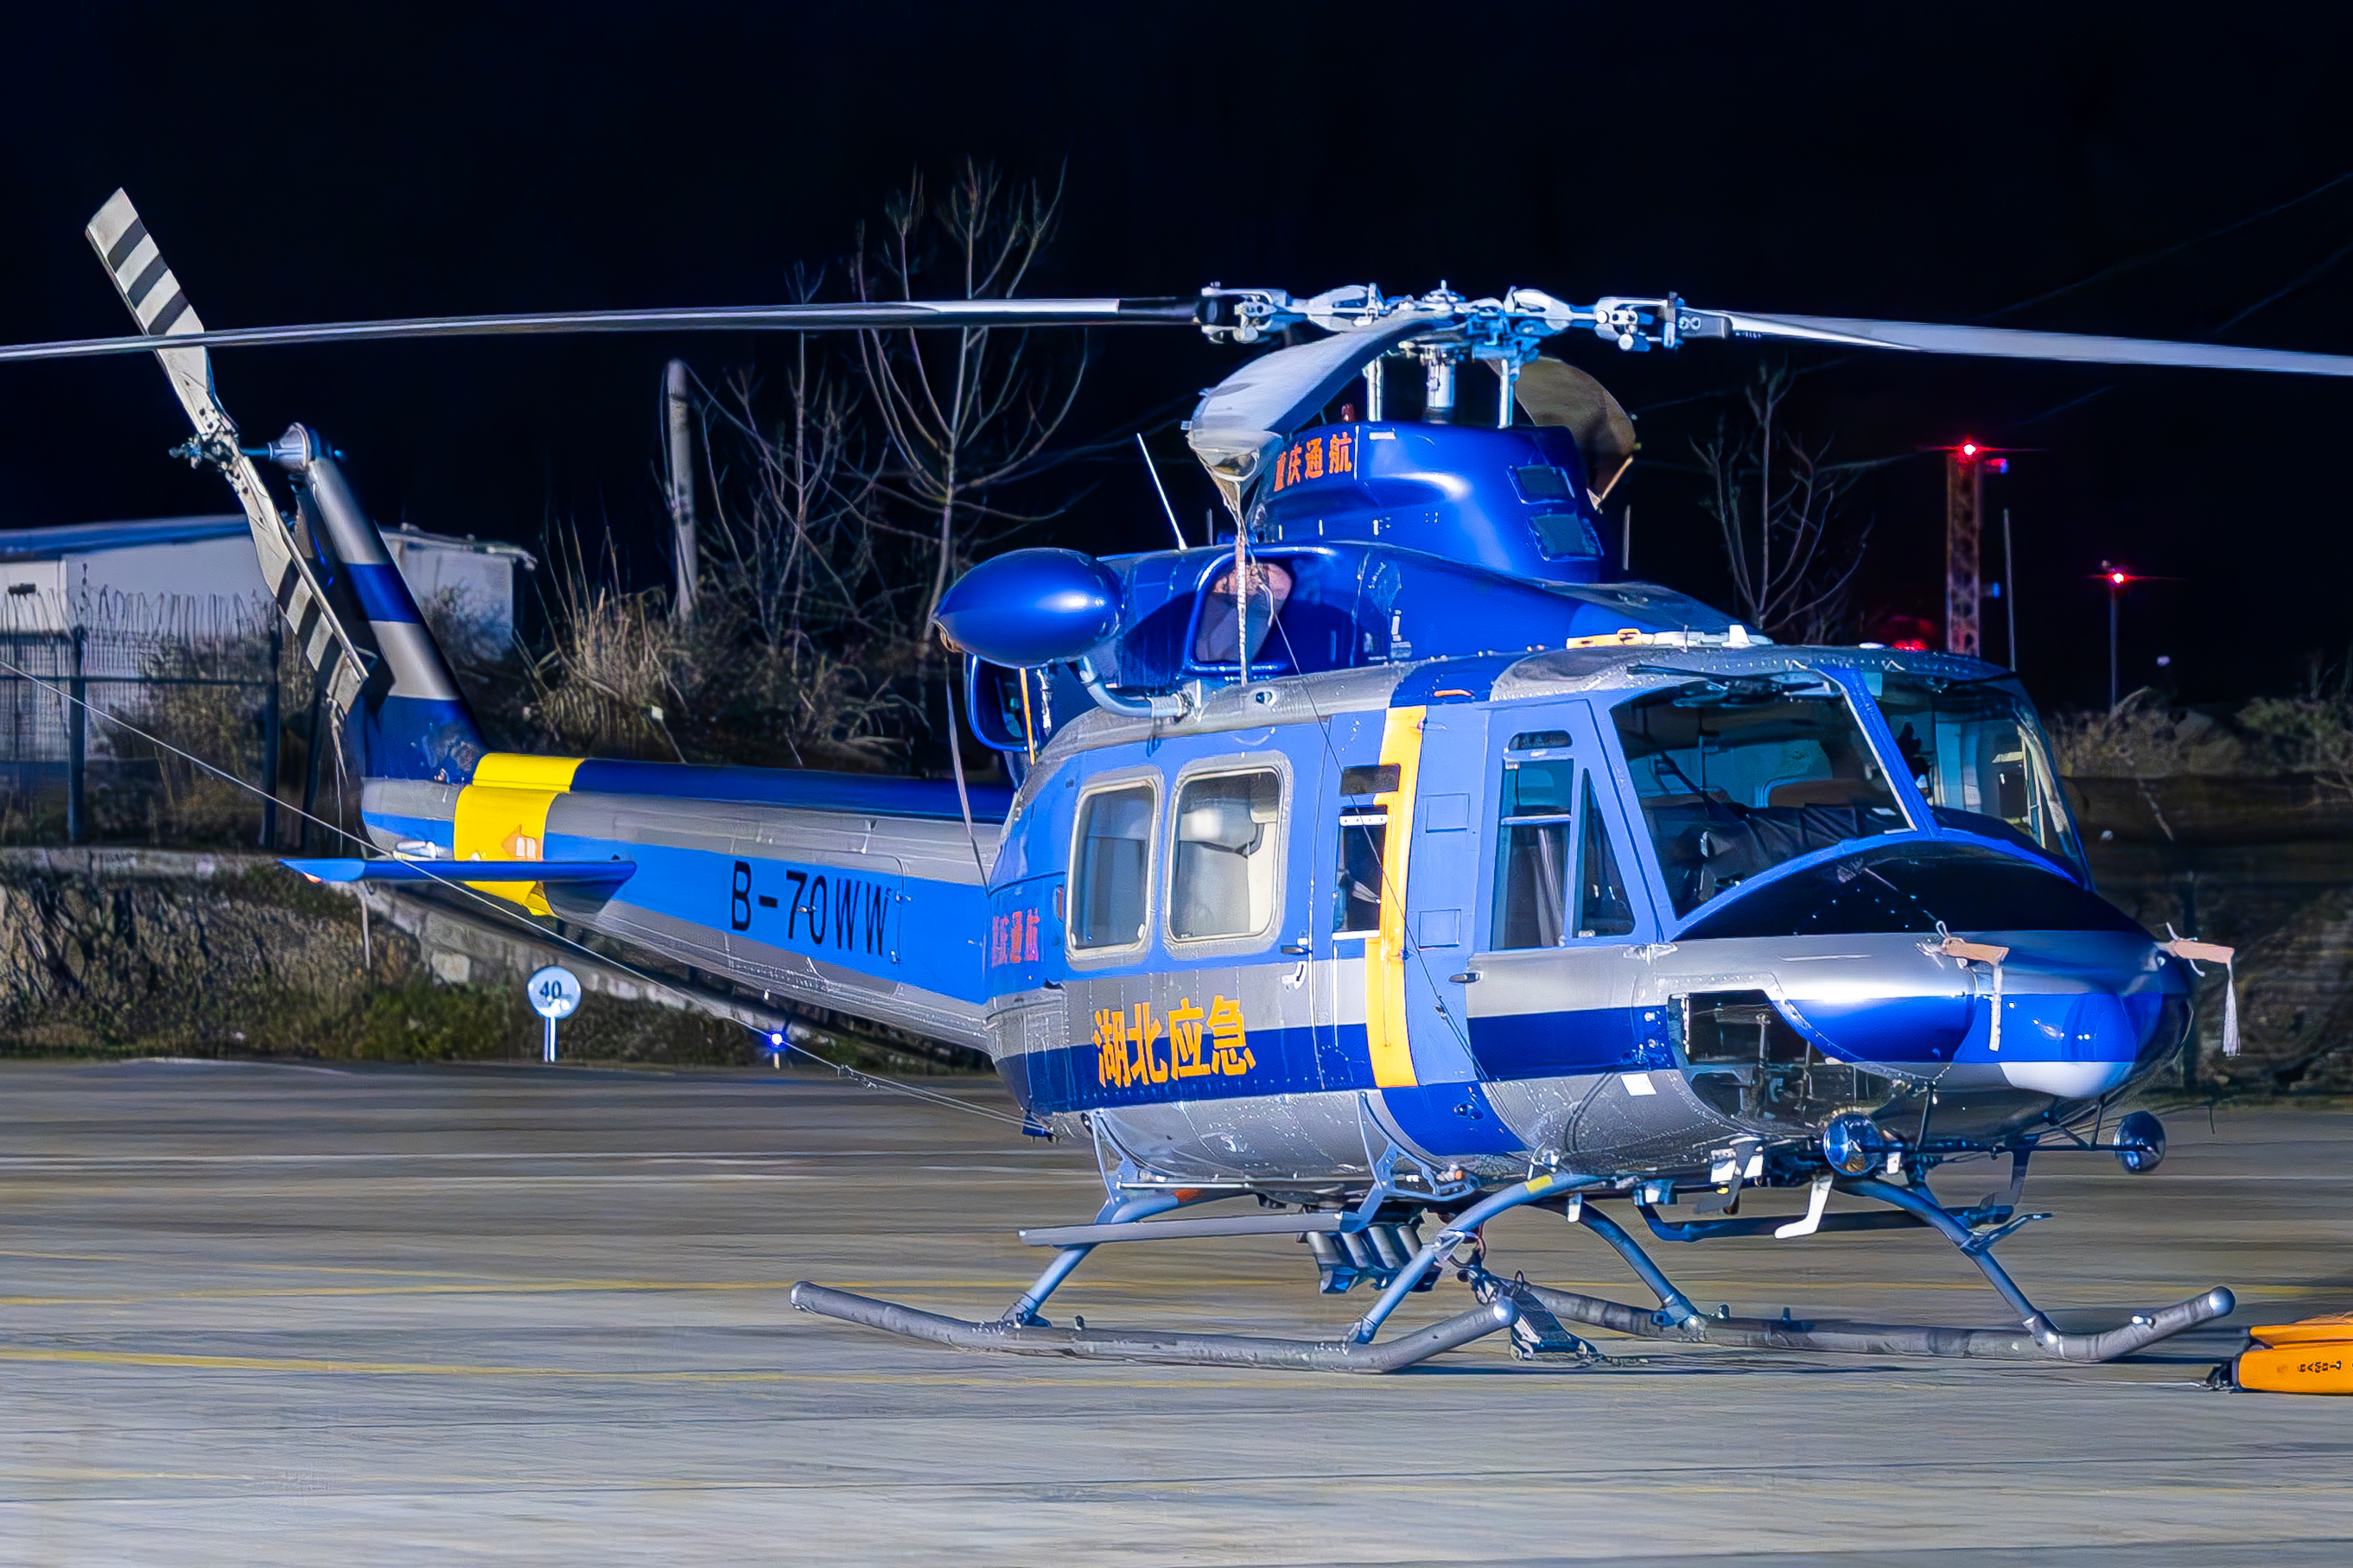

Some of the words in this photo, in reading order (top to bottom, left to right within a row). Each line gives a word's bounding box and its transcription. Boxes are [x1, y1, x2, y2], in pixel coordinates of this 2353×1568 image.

[731, 860, 894, 956] B-70WW
[539, 980, 563, 999] 40
[1092, 994, 1256, 1089] 湖北应急
